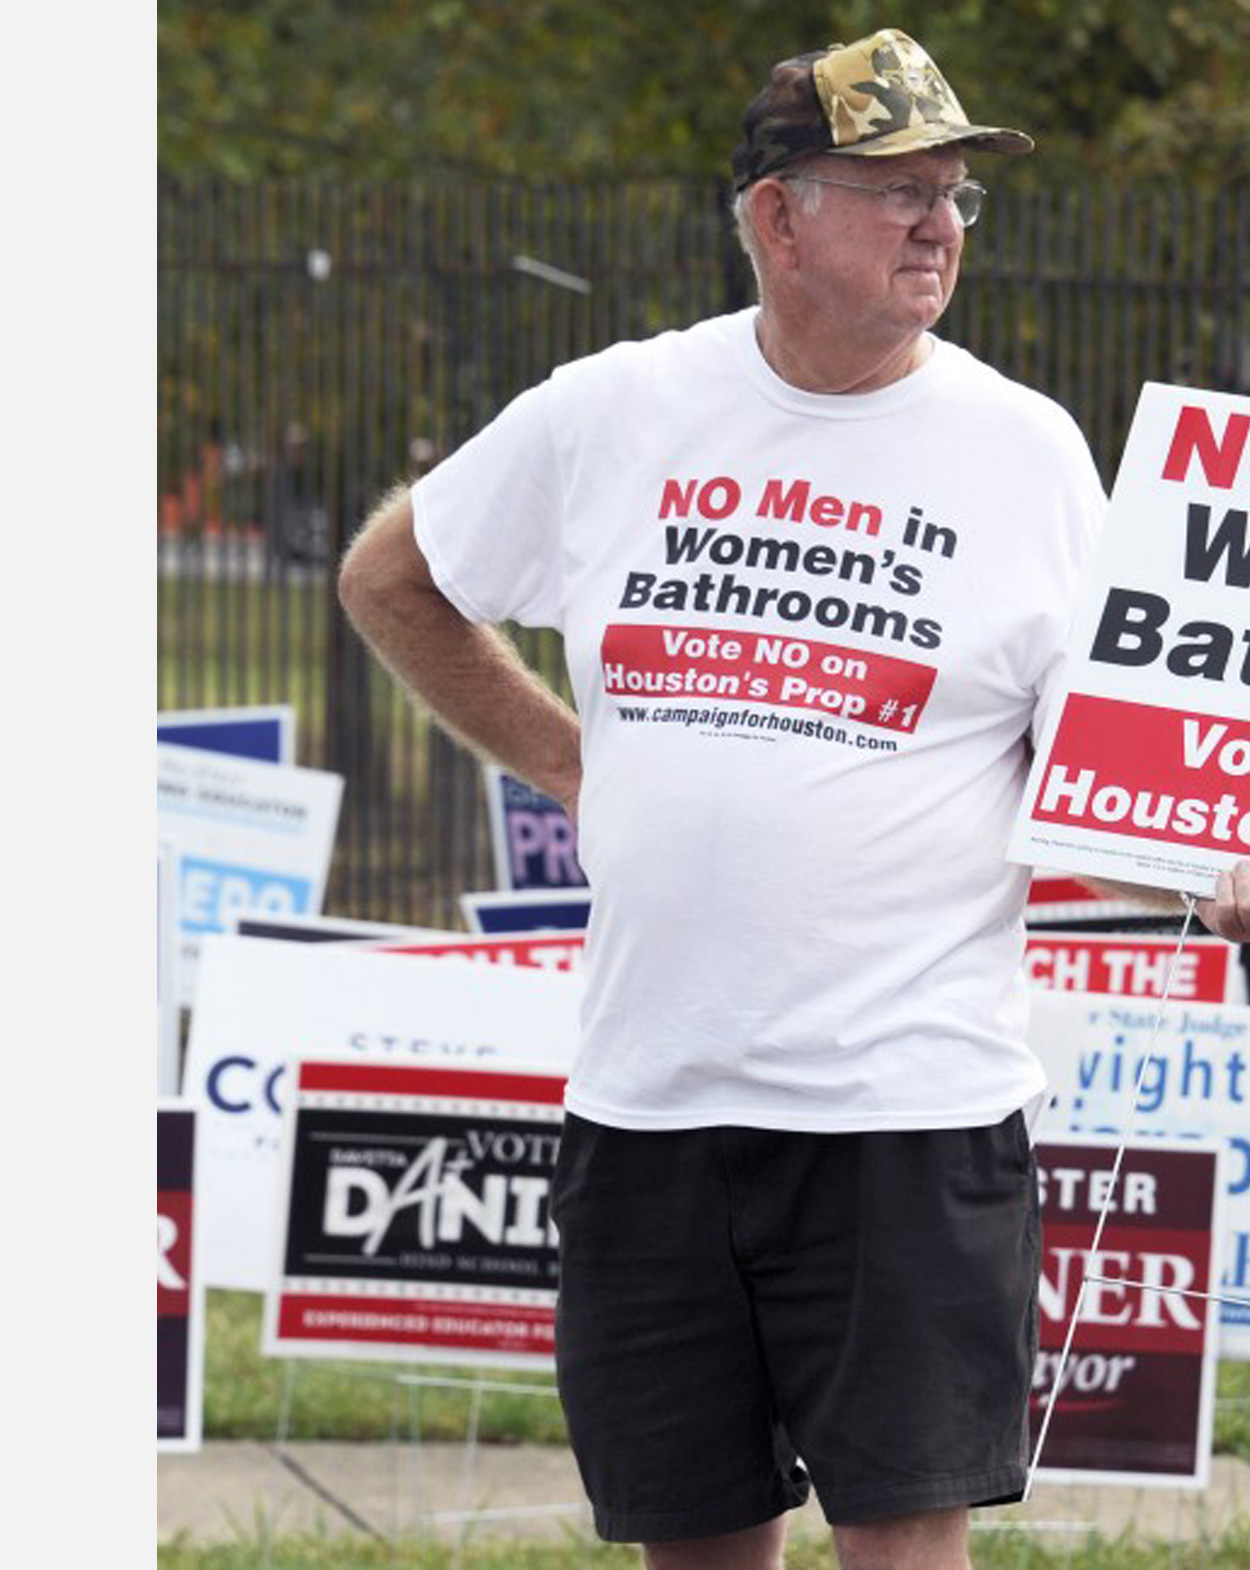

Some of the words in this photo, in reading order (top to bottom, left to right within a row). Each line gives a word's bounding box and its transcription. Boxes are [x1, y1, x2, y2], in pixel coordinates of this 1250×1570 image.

[658, 477, 741, 520] NO
[756, 480, 883, 536] Men
[903, 507, 958, 558] in
[664, 527, 924, 597] Women's
[619, 571, 943, 650] Bathrooms
[662, 630, 742, 660] Vote
[754, 638, 810, 669] NO
[821, 653, 867, 680] on
[605, 664, 769, 699] Houston's
[779, 676, 866, 719] Prop
[877, 702, 918, 727] #1
[617, 706, 898, 752] www.campaignforhouston.com
[1102, 950, 1199, 997] THE
